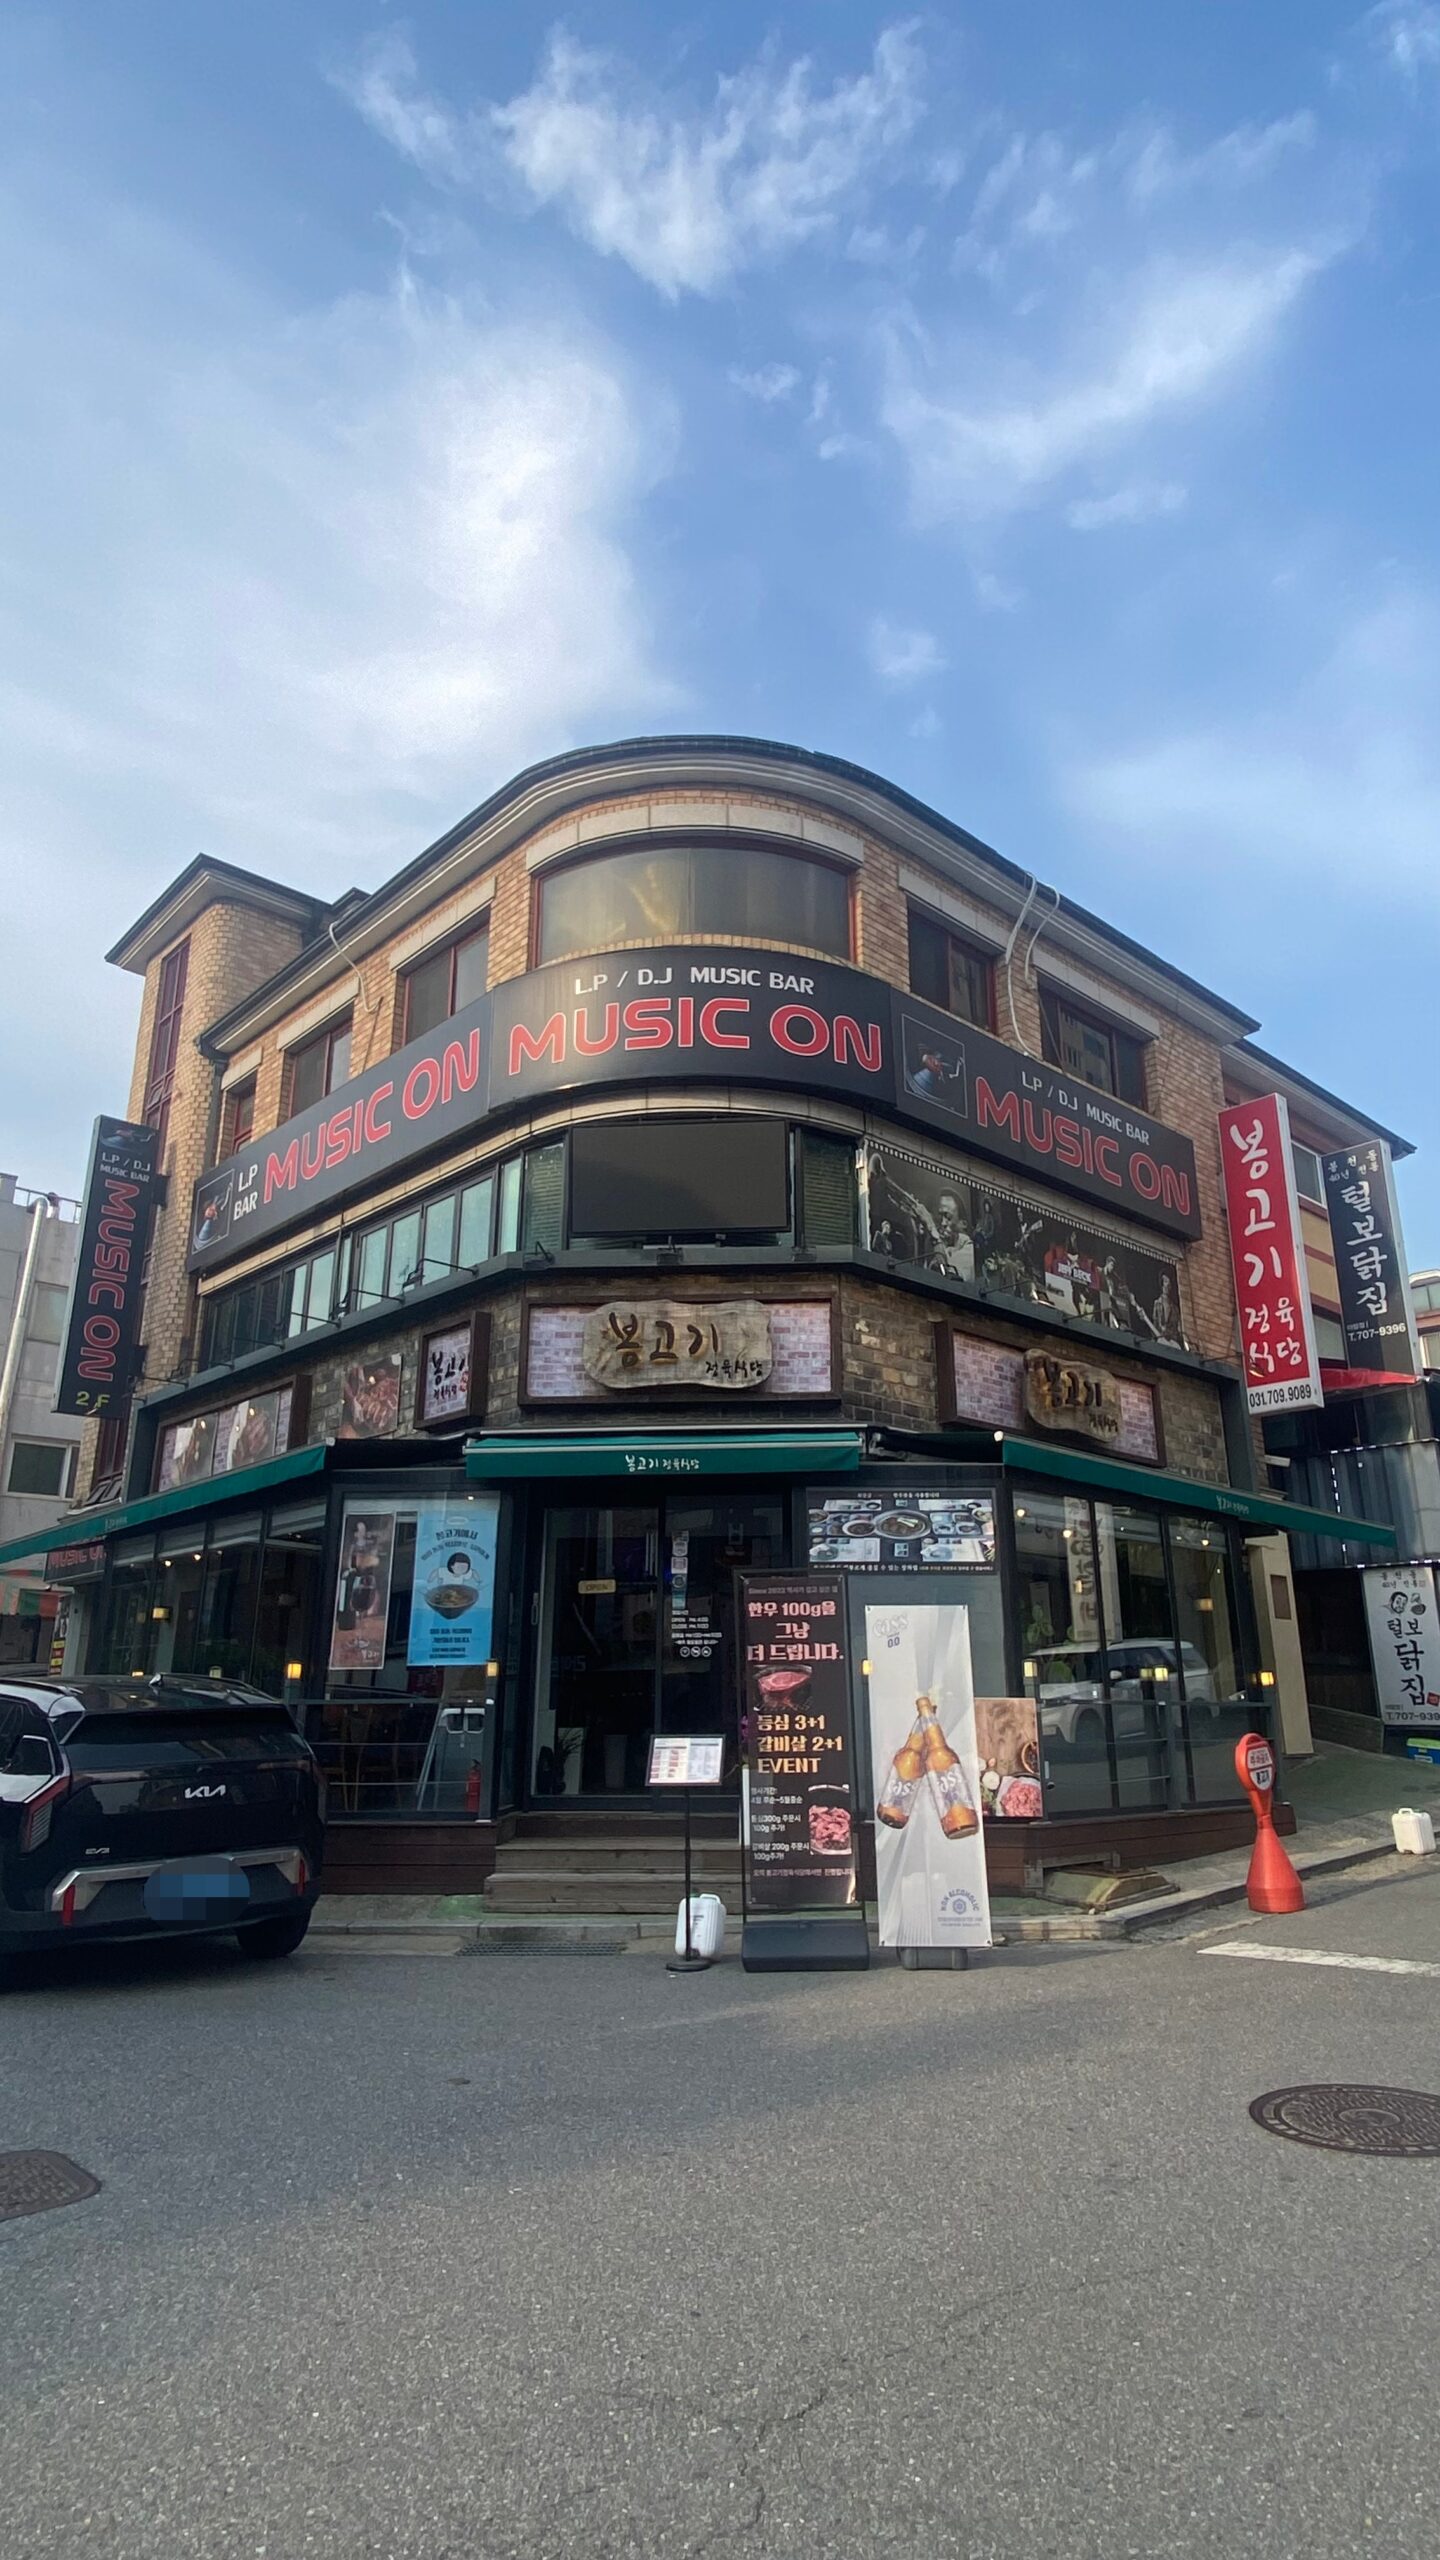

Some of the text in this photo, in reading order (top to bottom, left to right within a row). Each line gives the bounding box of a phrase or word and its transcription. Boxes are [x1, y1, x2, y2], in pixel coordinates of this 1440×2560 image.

[691, 968, 761, 986] MUSIC
[770, 974, 815, 995] BAR
[508, 997, 883, 1075] MUSIC ON
[263, 1027, 481, 1205] MUSIC ON
[1086, 1103, 1123, 1133] MUSIC
[1126, 1122, 1150, 1146] BAR
[975, 1076, 1191, 1216] MUSIC ON
[100, 1163, 150, 1184] MUSIC BAR
[233, 1191, 258, 1221] BAR
[1229, 1118, 1284, 1288] 봉고기
[1339, 1180, 1389, 1317] 털보닭집
[77, 1179, 140, 1382] MUSIC ON
[1244, 1296, 1295, 1334] 정육
[608, 1311, 719, 1369] 봉고기
[1347, 1322, 1406, 1343] T.707-9396
[1248, 1336, 1303, 1374] 식당
[705, 1360, 764, 1379] 정육식당
[1249, 1384, 1312, 1409] 031.709.9089
[625, 1454, 700, 1472] 봉고기 정육식당
[748, 1600, 836, 1617] 한우 100g을
[775, 1621, 810, 1639] 그냥
[1386, 1617, 1424, 1639] 털보
[747, 1642, 844, 1661] 더 드립니다.
[1393, 1639, 1426, 1706] 닭집
[757, 1713, 825, 1731] 등심 3+1
[757, 1735, 843, 1752] 갈비살 2+1
[757, 1757, 821, 1774] EVENT
[753, 1824, 770, 1833] 100g
[782, 1814, 802, 1823] 주문시
[771, 1843, 790, 1852] 200g
[790, 1842, 810, 1851] 주문시
